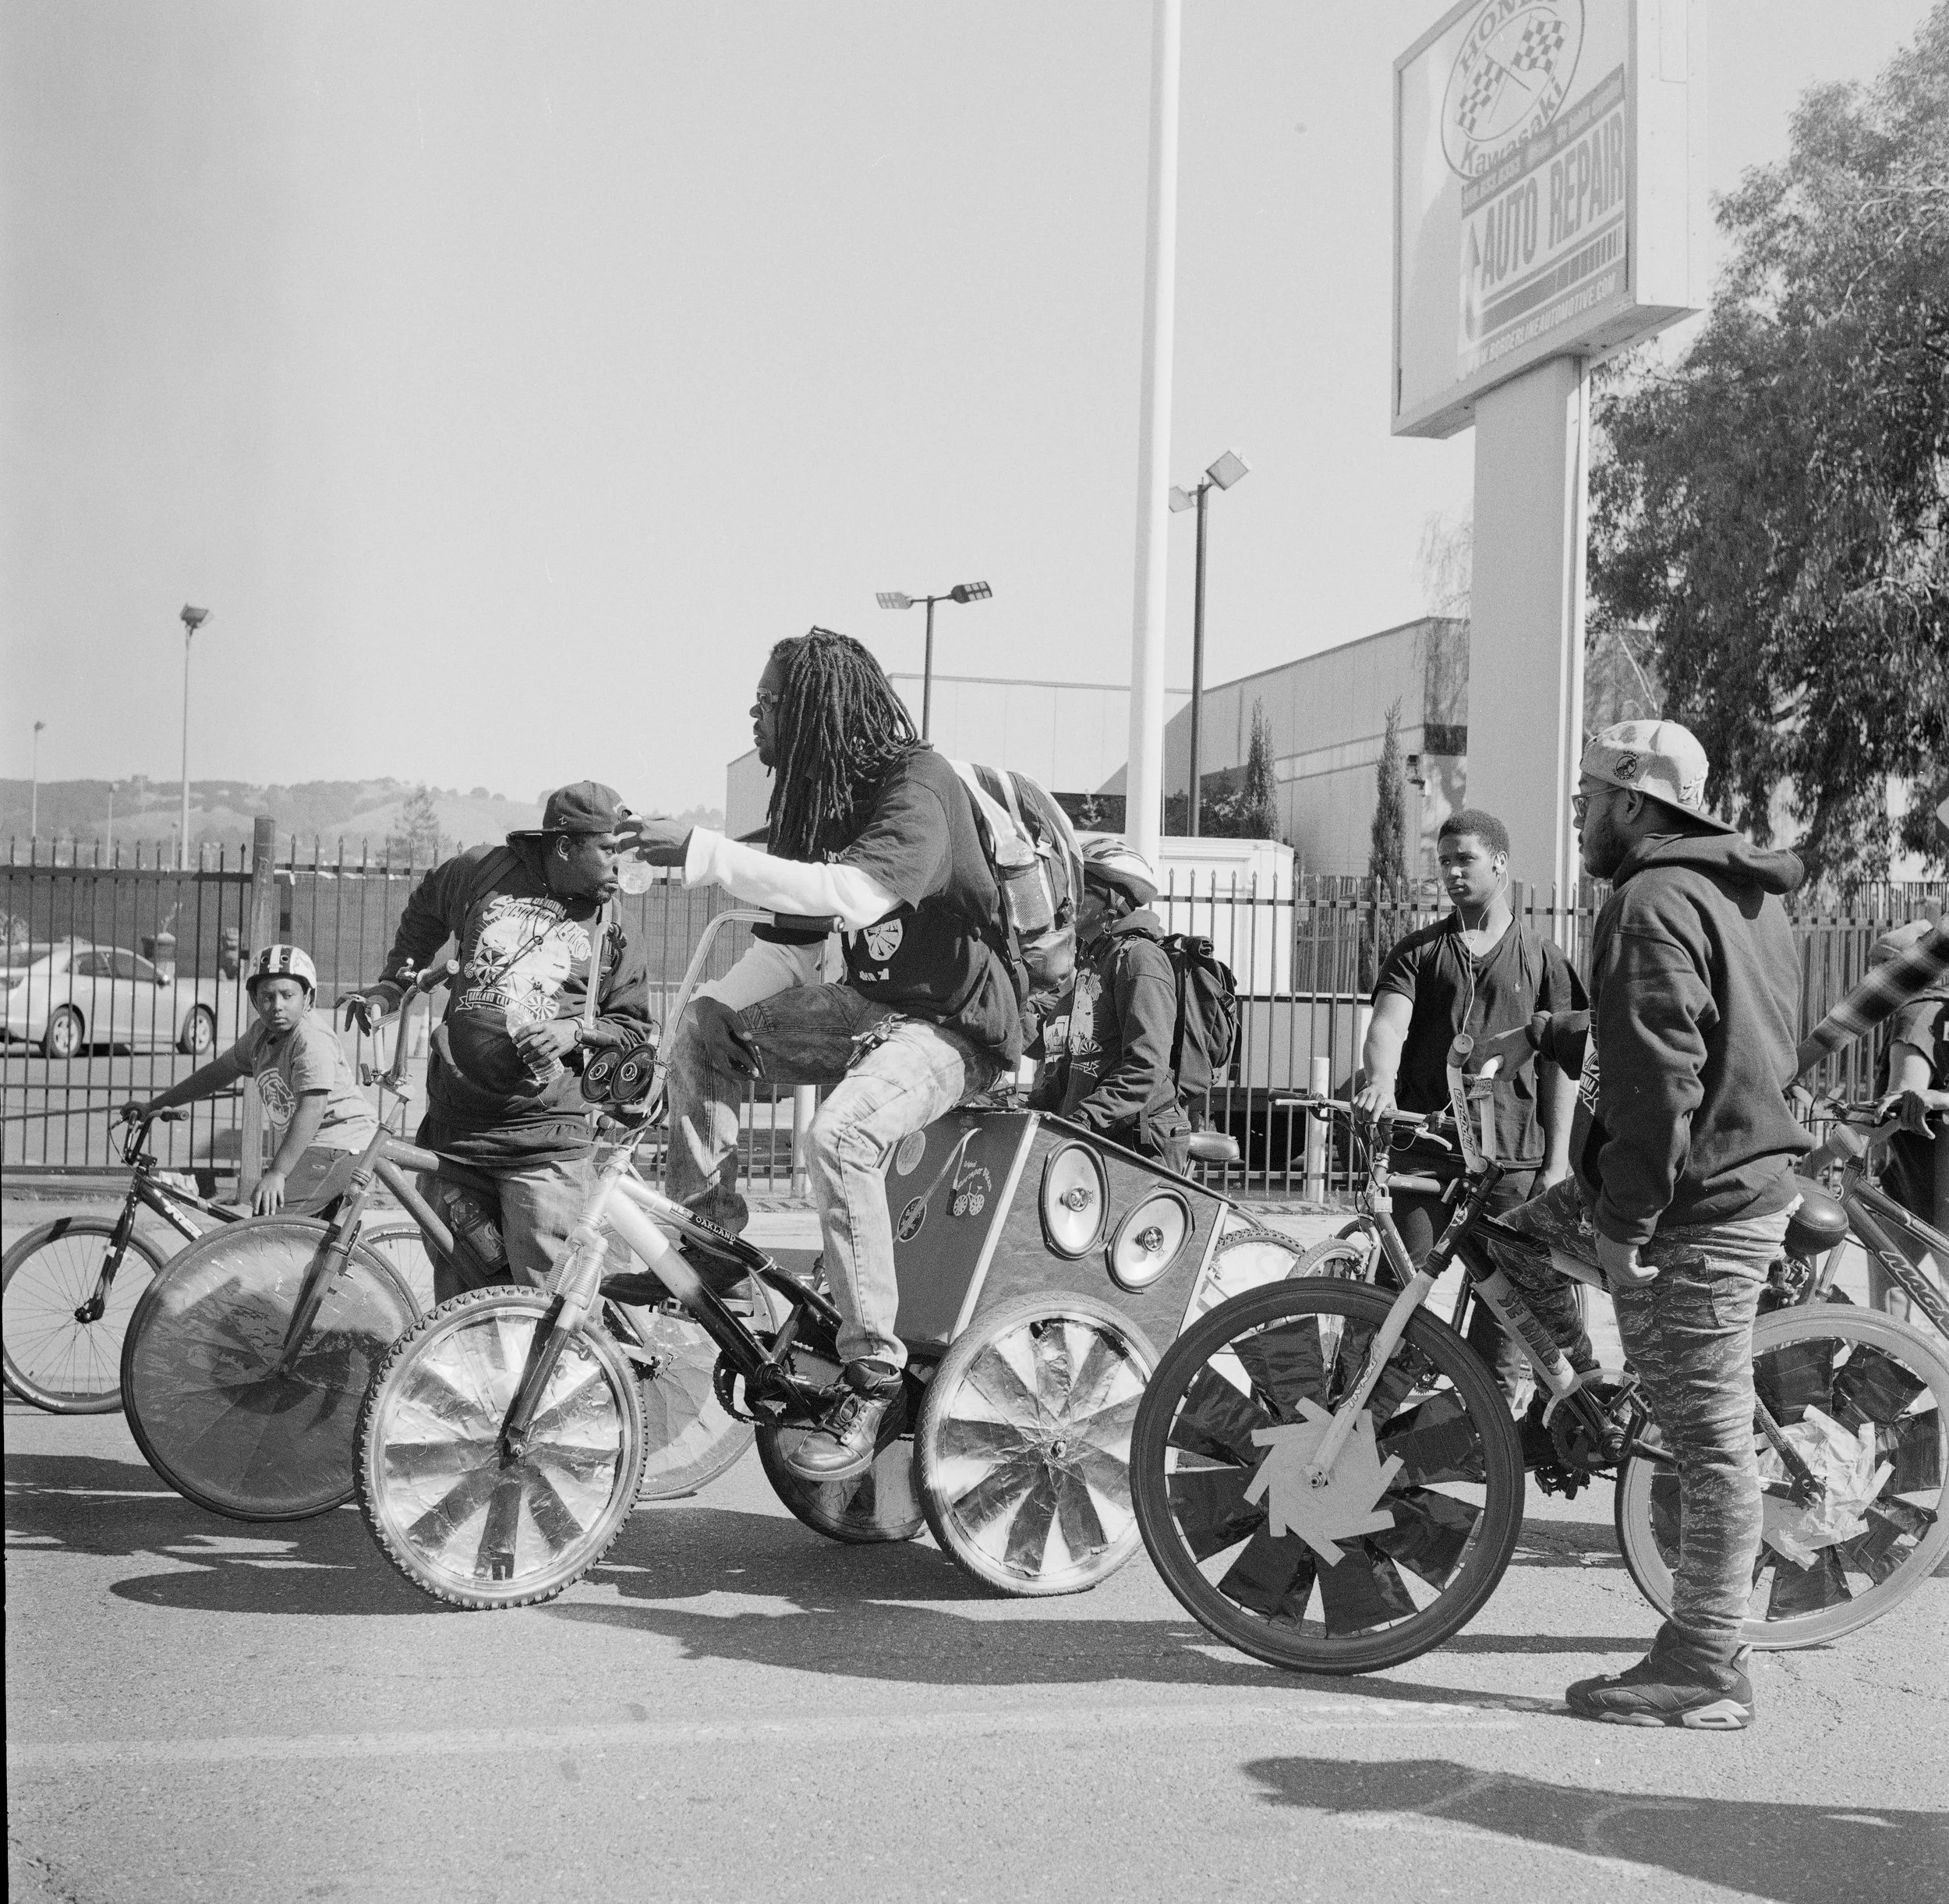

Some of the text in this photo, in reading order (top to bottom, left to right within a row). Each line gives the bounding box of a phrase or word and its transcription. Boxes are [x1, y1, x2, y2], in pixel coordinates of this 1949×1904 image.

[1481, 177, 1538, 291] AUTO
[1548, 111, 1623, 250] REPAIR
[695, 1216, 736, 1242] OAKLAND
[1496, 1289, 1572, 1376] SE BIKES
